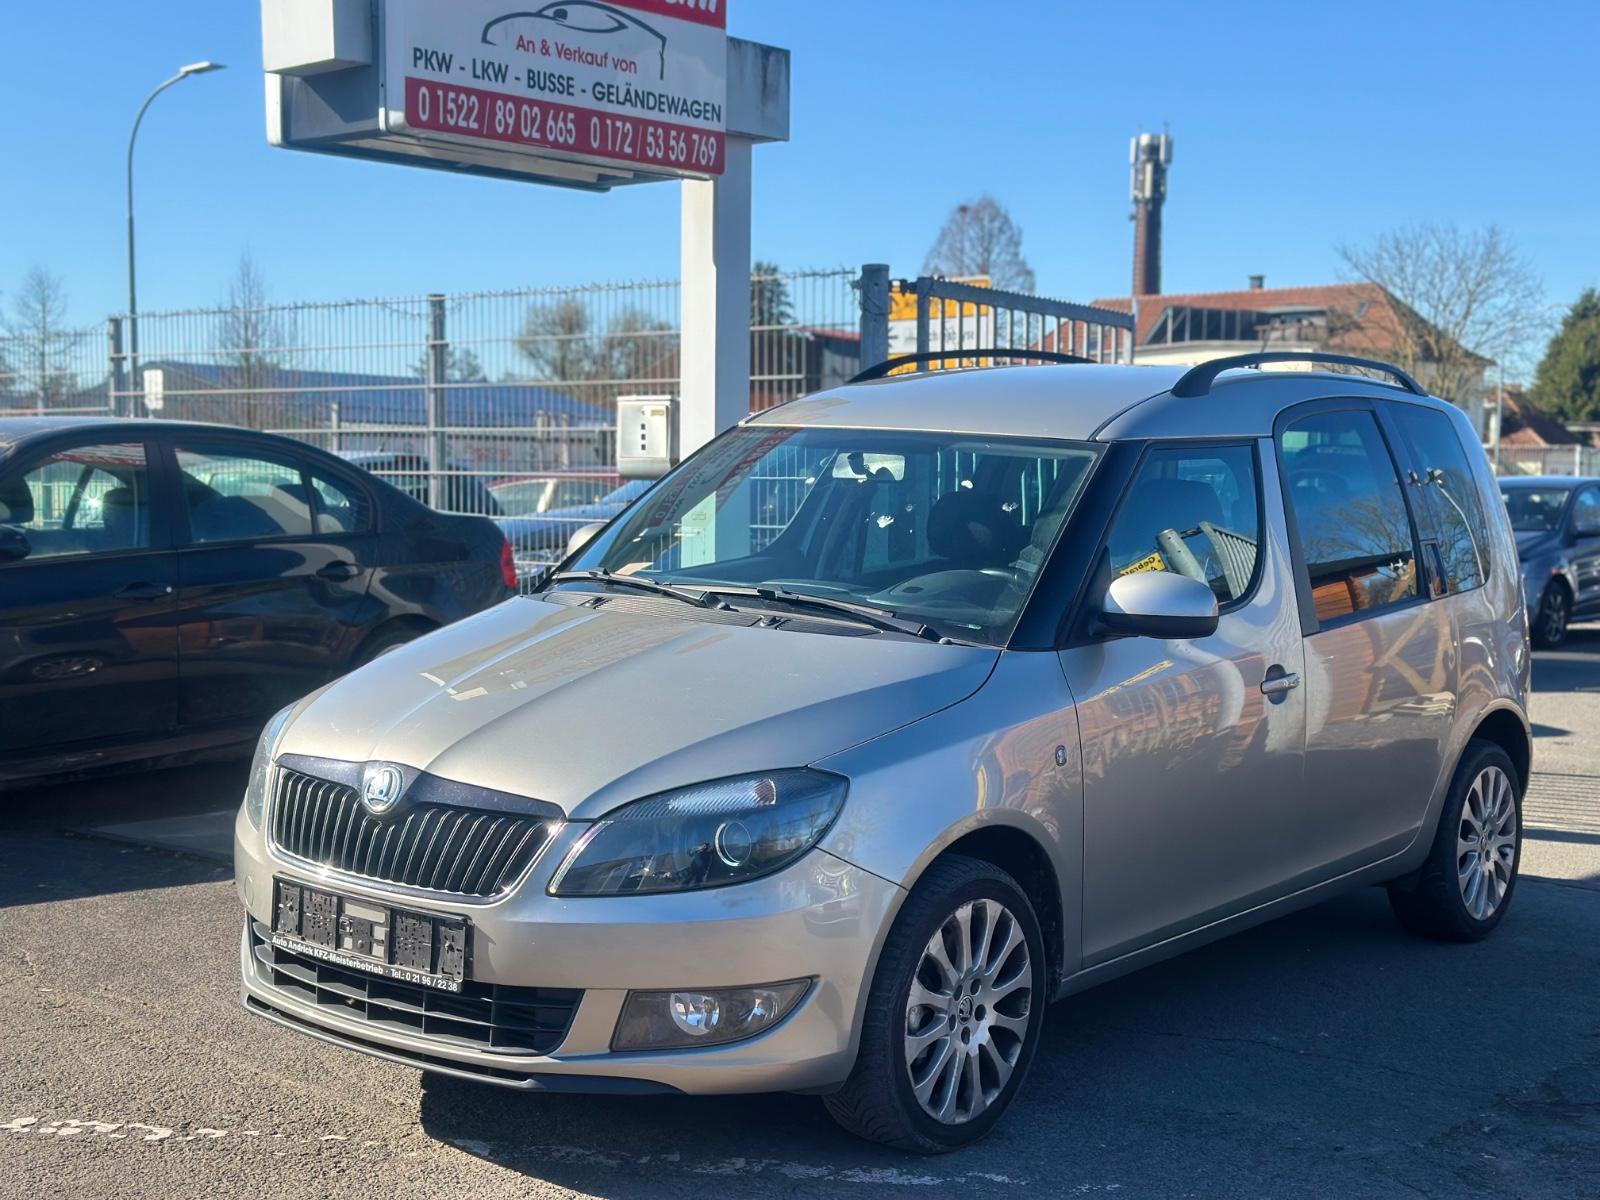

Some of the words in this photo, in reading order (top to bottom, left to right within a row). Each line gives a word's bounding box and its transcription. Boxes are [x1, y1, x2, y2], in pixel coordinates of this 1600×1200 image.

[516, 34, 535, 53] An
[540, 39, 551, 57] &
[555, 41, 608, 69] Verkauf
[612, 57, 637, 74] von
[413, 47, 453, 74] PKW
[472, 58, 509, 84] LKW
[527, 68, 575, 97] BUSSE
[592, 81, 722, 123] GELÄNDEWAGEN
[418, 86, 429, 122] 0
[437, 89, 479, 129] 1522
[495, 99, 516, 135] 89
[520, 104, 541, 139] 02
[546, 109, 576, 145] 665
[590, 116, 600, 149] 0
[606, 119, 633, 154] 172
[646, 126, 664, 159] 53
[669, 130, 687, 162] 56
[691, 134, 717, 167] 769
[272, 935, 287, 947] Auto
[314, 948, 384, 975] KFZ-Meisterbetrieb
[412, 973, 420, 983] 21
[422, 976, 431, 986] 96
[437, 980, 447, 990] 22
